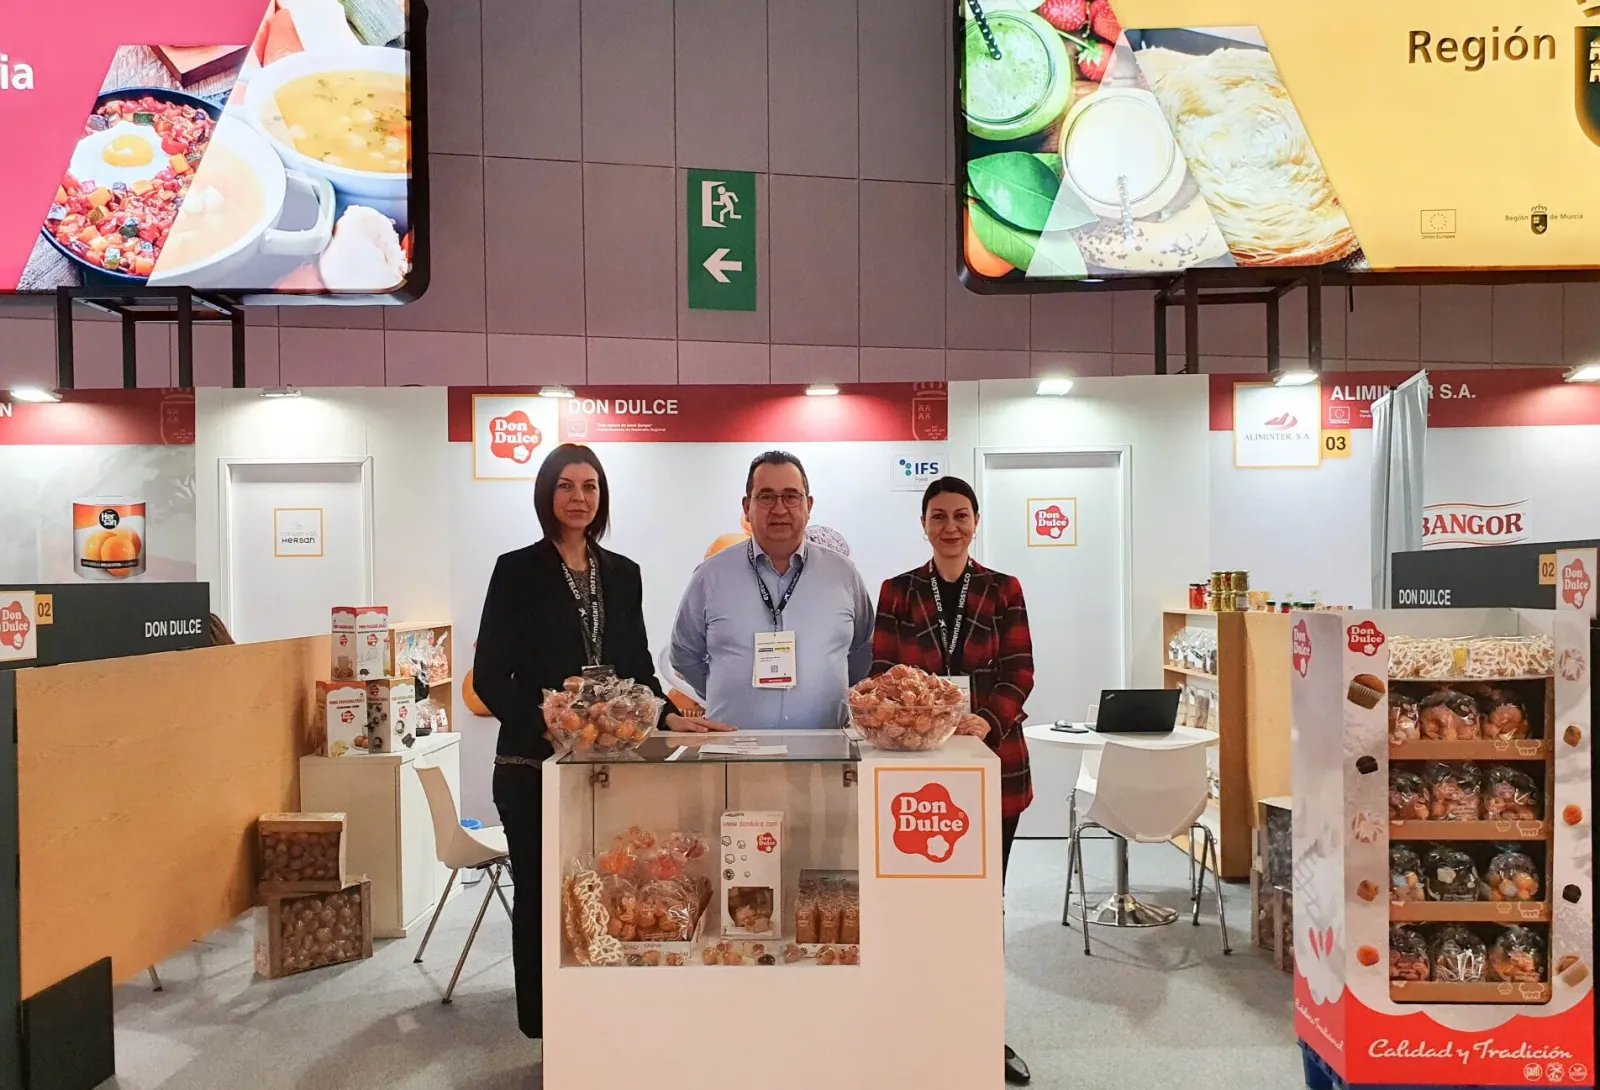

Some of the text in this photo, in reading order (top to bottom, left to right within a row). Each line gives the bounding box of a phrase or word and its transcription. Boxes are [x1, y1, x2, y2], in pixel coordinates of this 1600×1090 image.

[1408, 26, 1556, 71] Región
[1505, 214, 1529, 222] Región
[1439, 383, 1476, 399] S.A.
[568, 399, 678, 415] DON DULCE
[495, 419, 528, 432] Don
[494, 431, 539, 444] Dulce
[1325, 436, 1346, 451] 03
[915, 462, 939, 475] IFS
[1038, 511, 1060, 519] Don
[1038, 519, 1067, 527] Dulce
[1542, 562, 1555, 578] 02
[1565, 568, 1583, 578] Don
[958, 572, 971, 608] HOSTELCO
[1564, 579, 1589, 590] Dulce
[931, 577, 943, 612] HOSTELCO
[1399, 589, 1451, 605] DON DULCE
[2, 610, 22, 620] Don
[38, 602, 51, 617] 02
[2, 621, 29, 632] Dulce
[145, 619, 202, 637] DON DULCE
[591, 601, 599, 643] Alimentaria
[949, 614, 963, 655] Alimentaria
[1294, 628, 1306, 642] Don
[1351, 626, 1375, 635] Don
[1350, 634, 1382, 643] Dulce
[1293, 641, 1310, 656] Dulce
[899, 796, 947, 813] Don
[899, 814, 964, 832] Dulce
[1368, 1038, 1573, 1064] Calidad y Tradición
